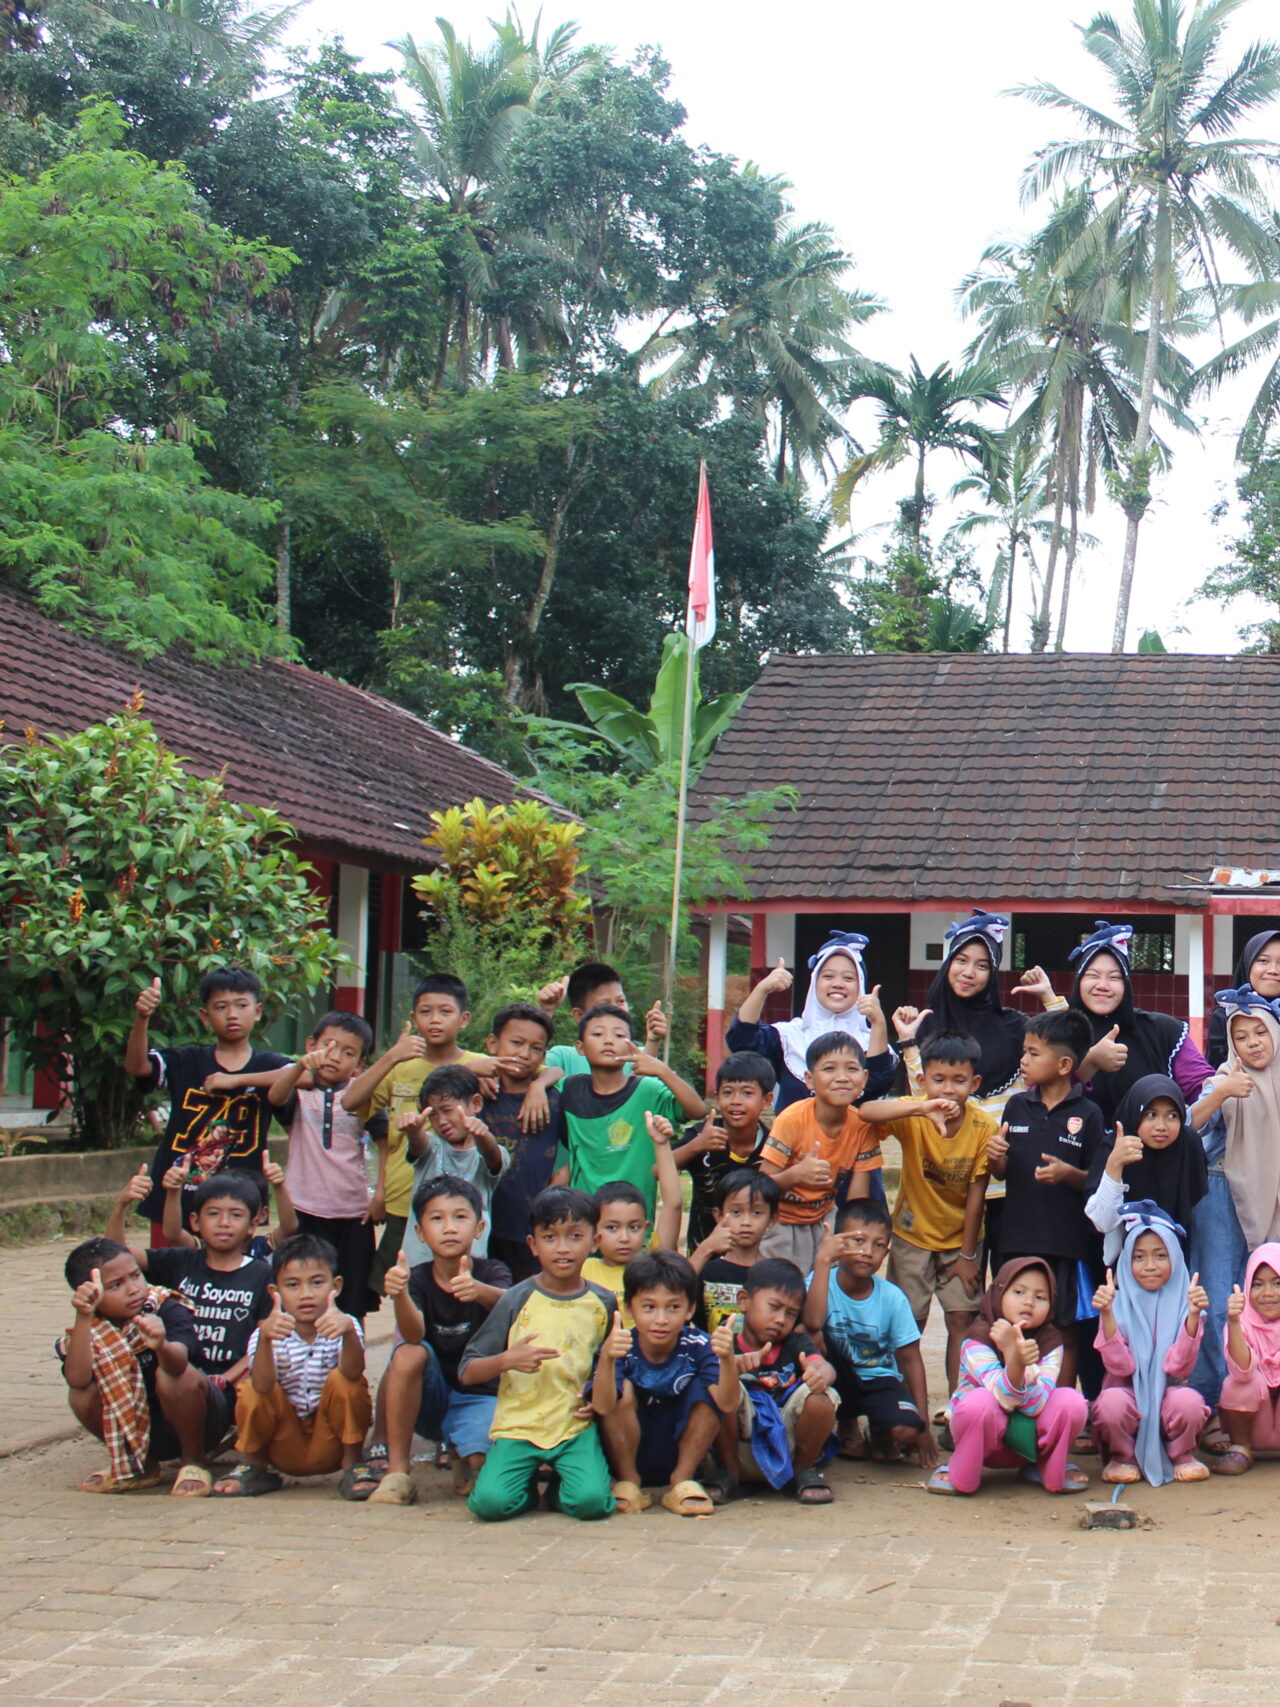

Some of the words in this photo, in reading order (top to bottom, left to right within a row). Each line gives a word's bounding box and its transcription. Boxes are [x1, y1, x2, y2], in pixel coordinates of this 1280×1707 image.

[171, 1088, 260, 1157] 79
[201, 1282, 253, 1306] Sayang
[194, 1305, 232, 1320] ama
